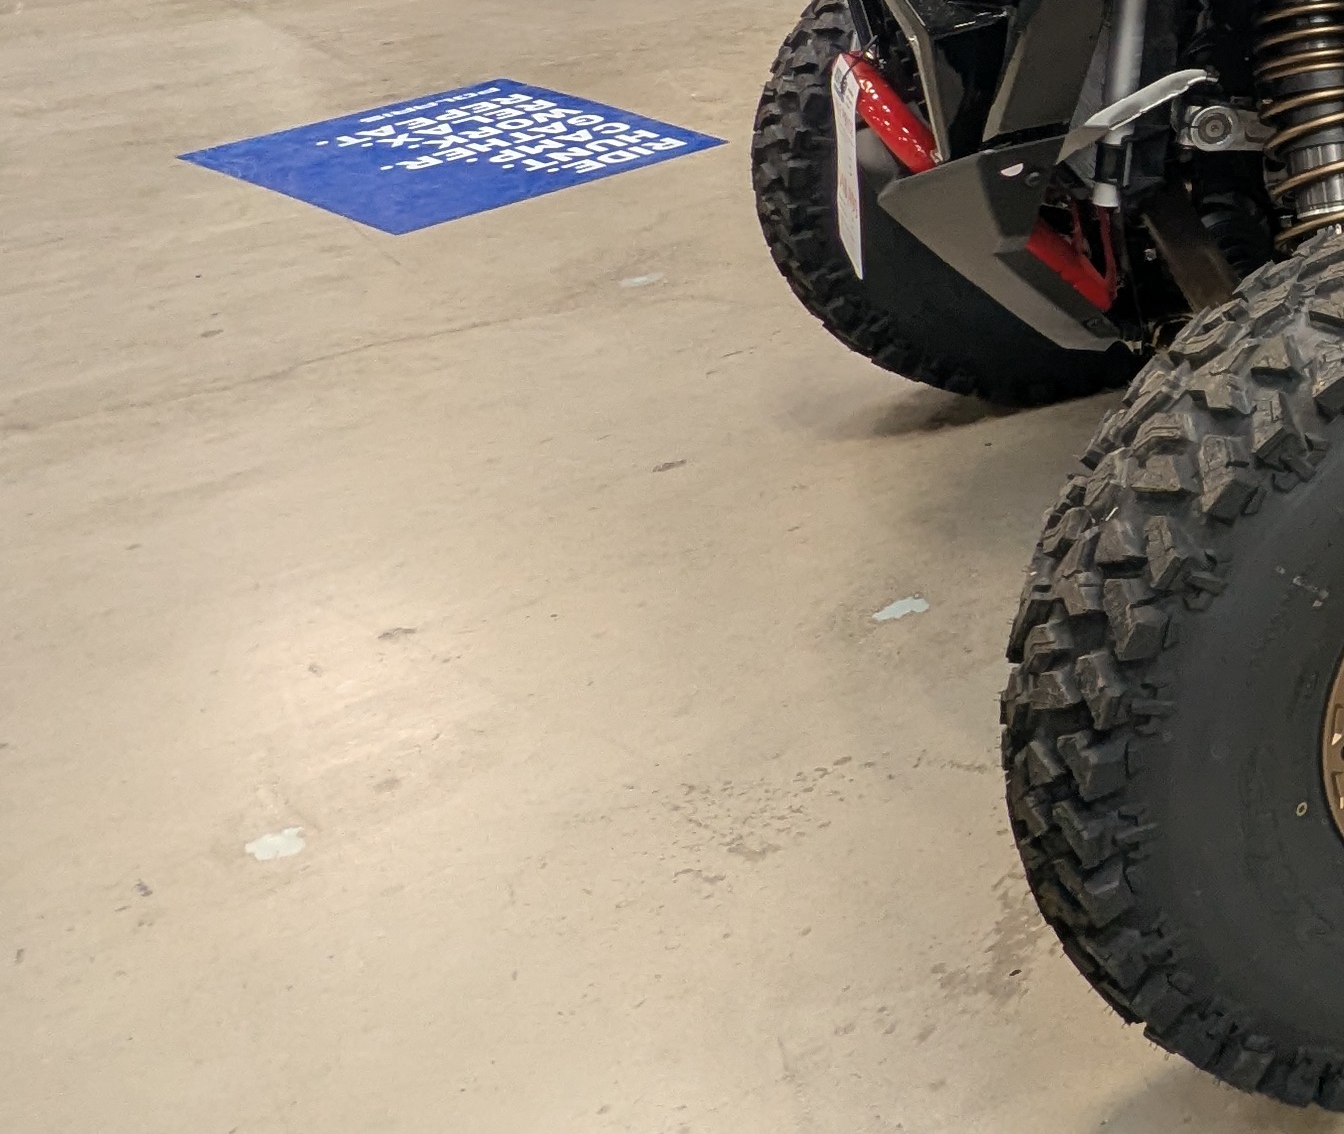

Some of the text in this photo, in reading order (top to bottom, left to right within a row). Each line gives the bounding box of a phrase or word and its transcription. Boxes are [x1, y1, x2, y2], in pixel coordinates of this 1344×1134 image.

[315, 92, 533, 148] REPEAT.
[358, 86, 501, 123] POLARIS
[360, 98, 557, 148] RELAX.
[379, 113, 605, 171] GATHER.
[406, 107, 584, 150] WORK.
[464, 121, 631, 163] CAMP.
[501, 128, 660, 172] HUNT.
[546, 136, 688, 174] RIDE.
